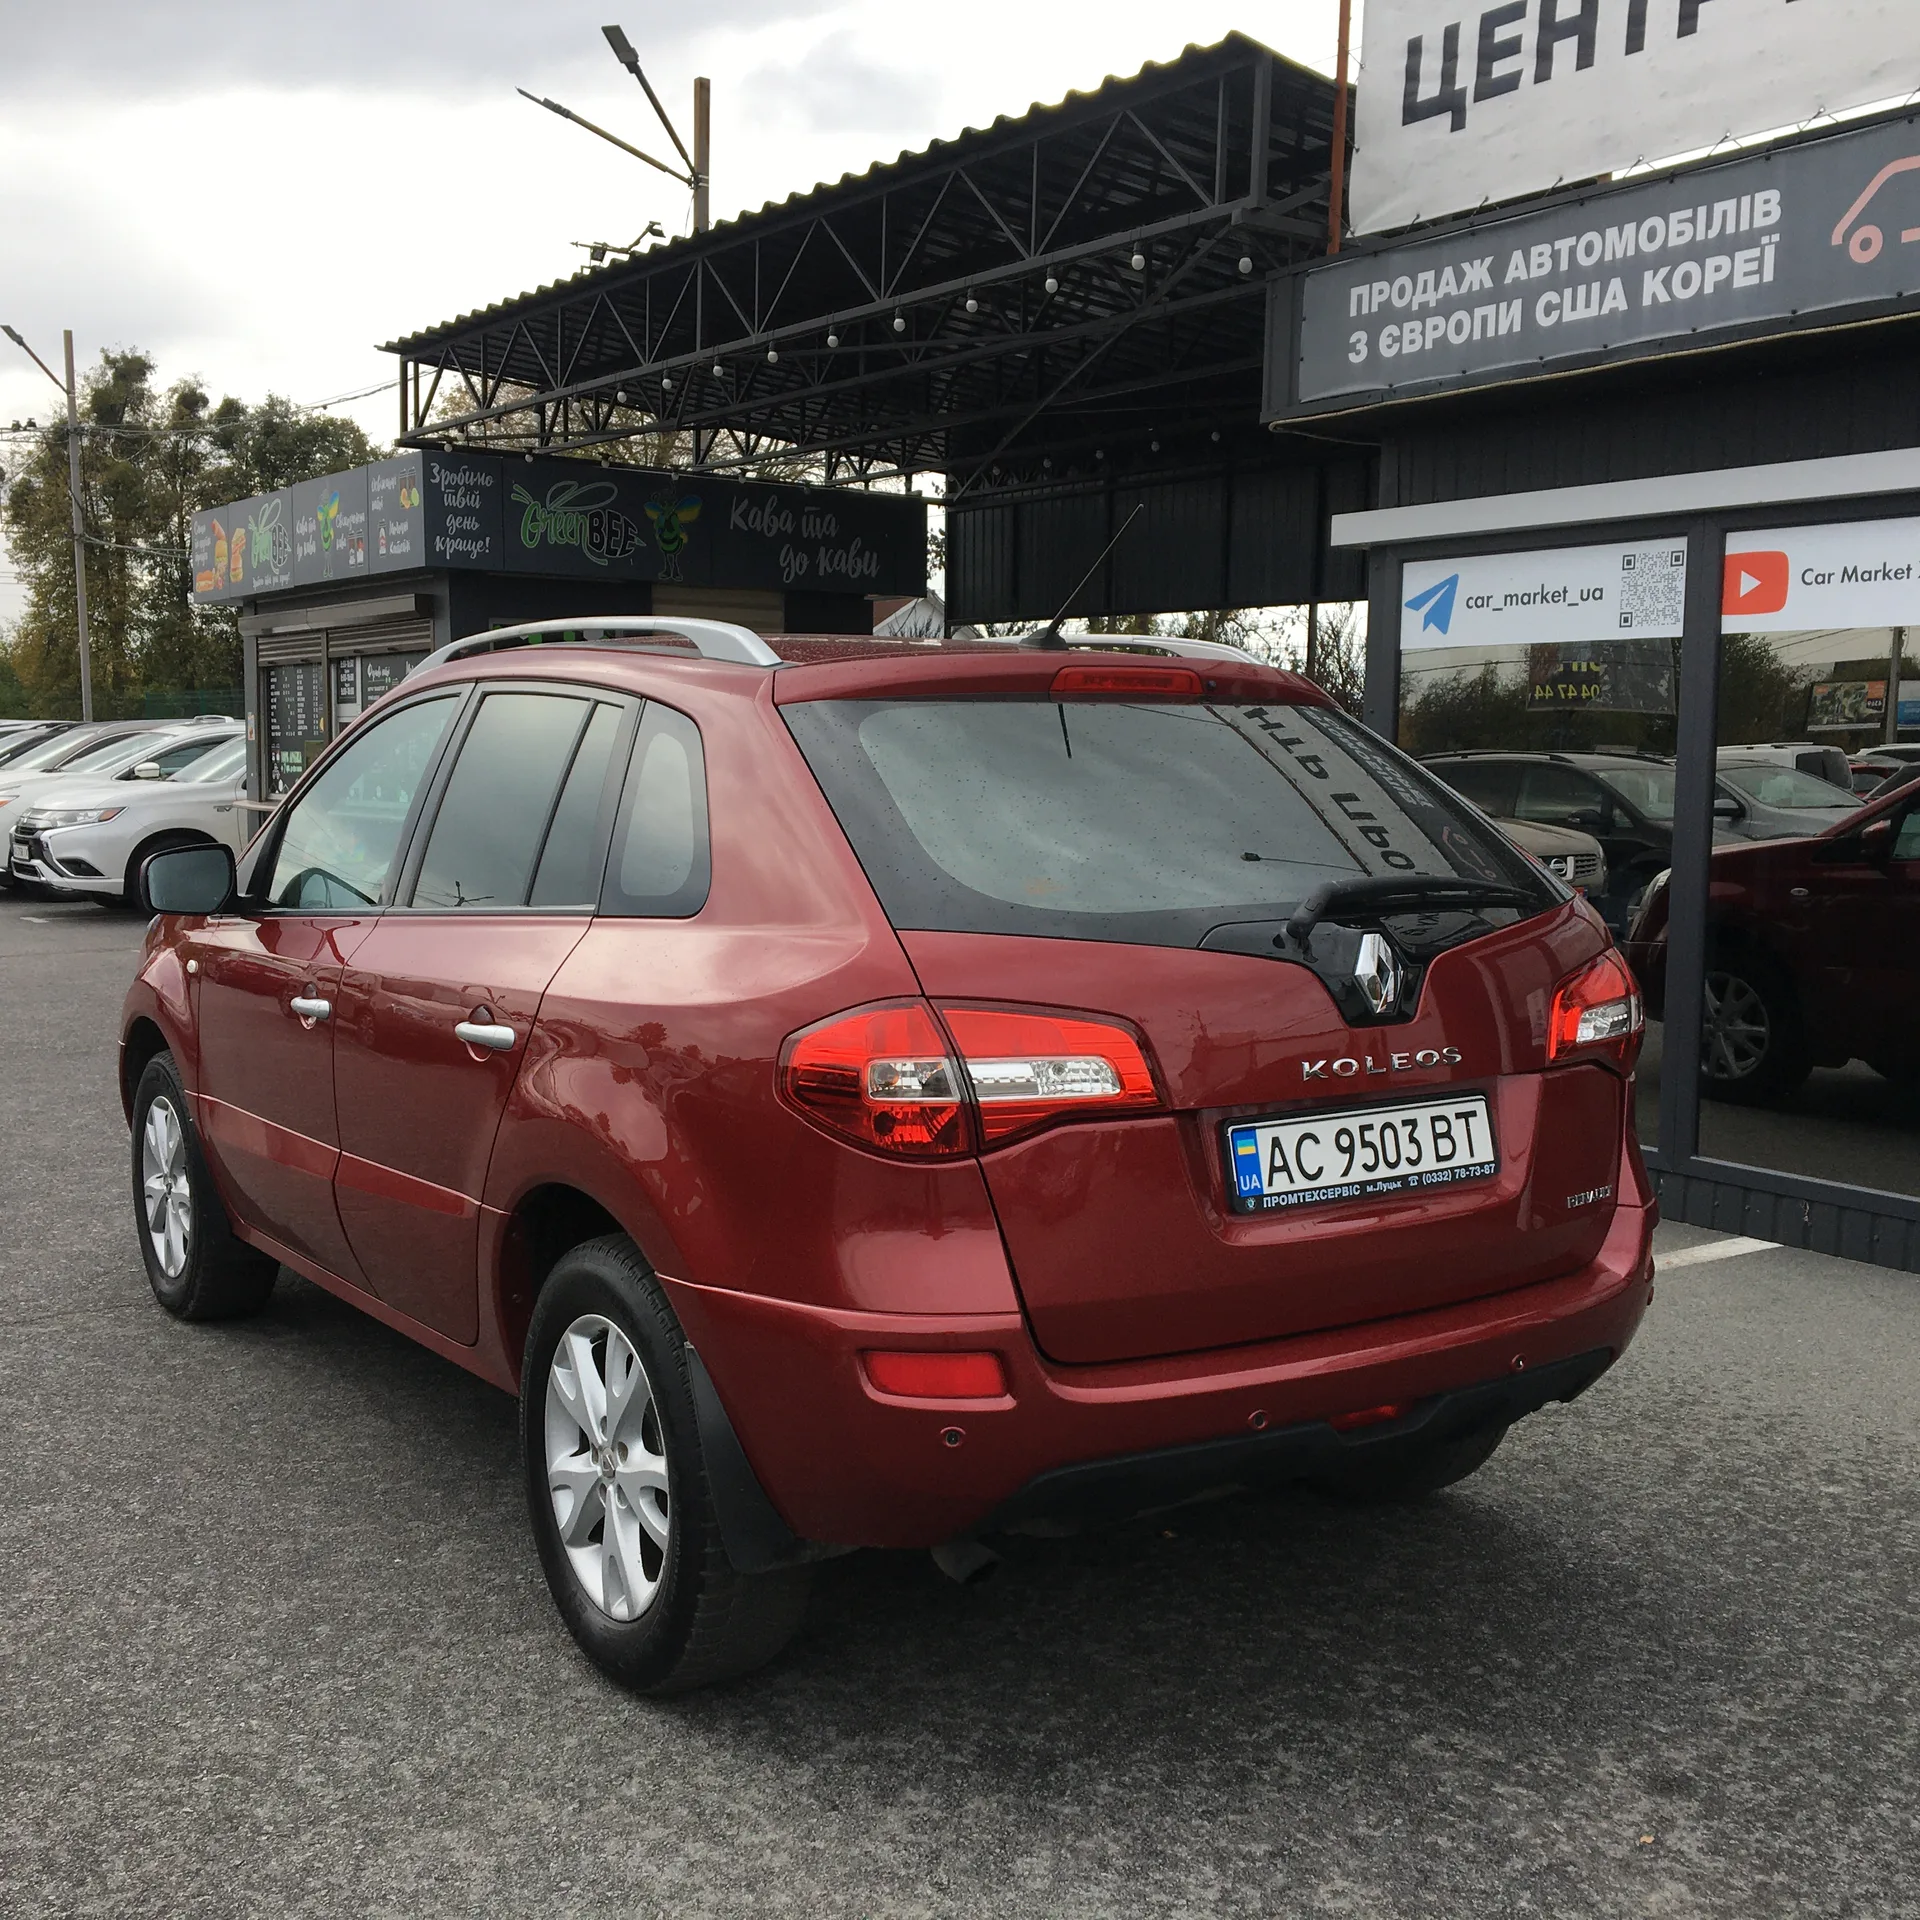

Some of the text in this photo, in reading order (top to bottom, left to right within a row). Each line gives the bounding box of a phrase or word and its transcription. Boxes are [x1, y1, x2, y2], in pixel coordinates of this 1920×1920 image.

[1350, 189, 1781, 317] ПРОДАЖ АВТОМОБІЛІВ
[1348, 233, 1780, 363] З ЄВРОПИ США КОРЕЇ
[430, 463, 494, 492] Зробимо
[444, 486, 482, 509] твій
[446, 514, 480, 535] день
[730, 495, 840, 540] Кава та
[434, 535, 492, 560] краще!
[779, 537, 880, 583] до кави
[1801, 568, 1835, 586] Car
[1840, 561, 1912, 583] Market
[1465, 583, 1604, 611] car_market_ua
[1301, 1047, 1463, 1081] KOLEOS
[1267, 1110, 1478, 1187] AC 9503 BT
[1240, 1173, 1261, 1191] UA
[1263, 1164, 1496, 1208] ПРОМТЕХСЕРВІС м.Луцьк (0332) 78-73-87
